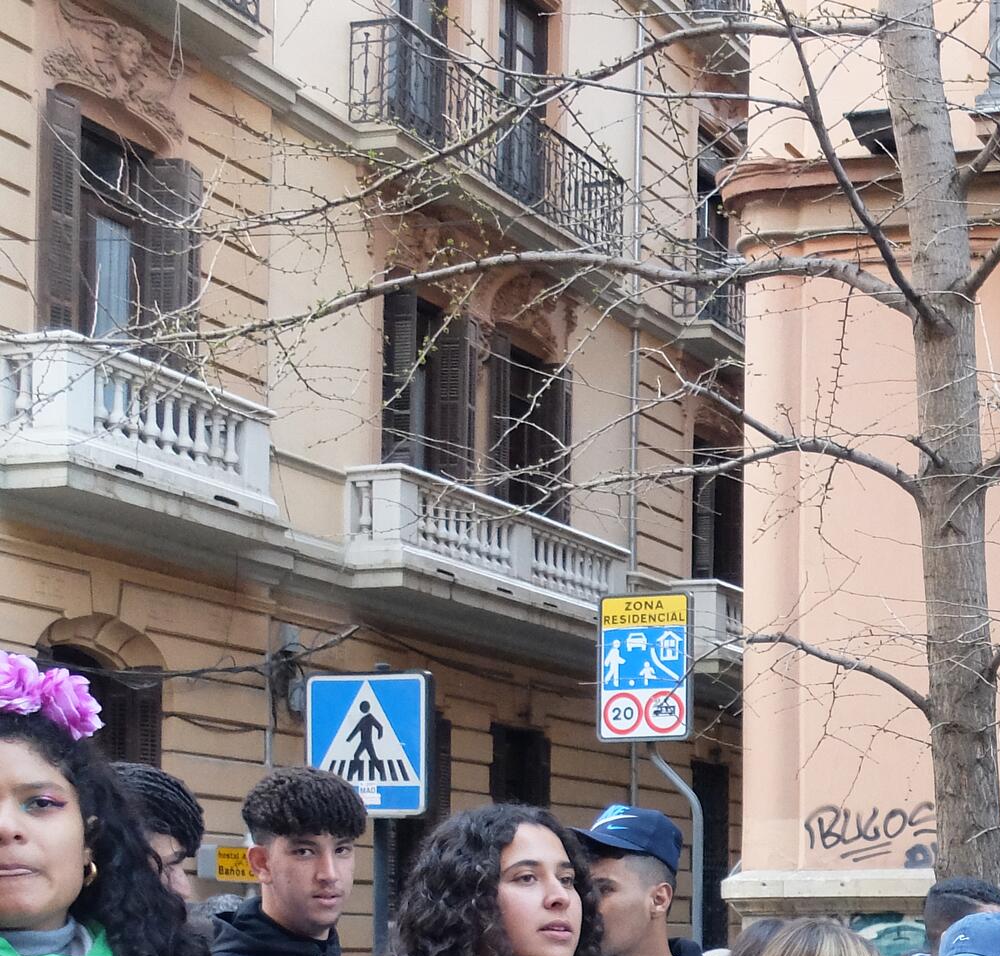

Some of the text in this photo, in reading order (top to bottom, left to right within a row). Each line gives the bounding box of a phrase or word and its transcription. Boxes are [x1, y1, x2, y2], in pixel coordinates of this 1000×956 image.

[624, 600, 664, 612] ZONA
[603, 612, 685, 625] RESIDENCIAL
[612, 707, 634, 721] 20
